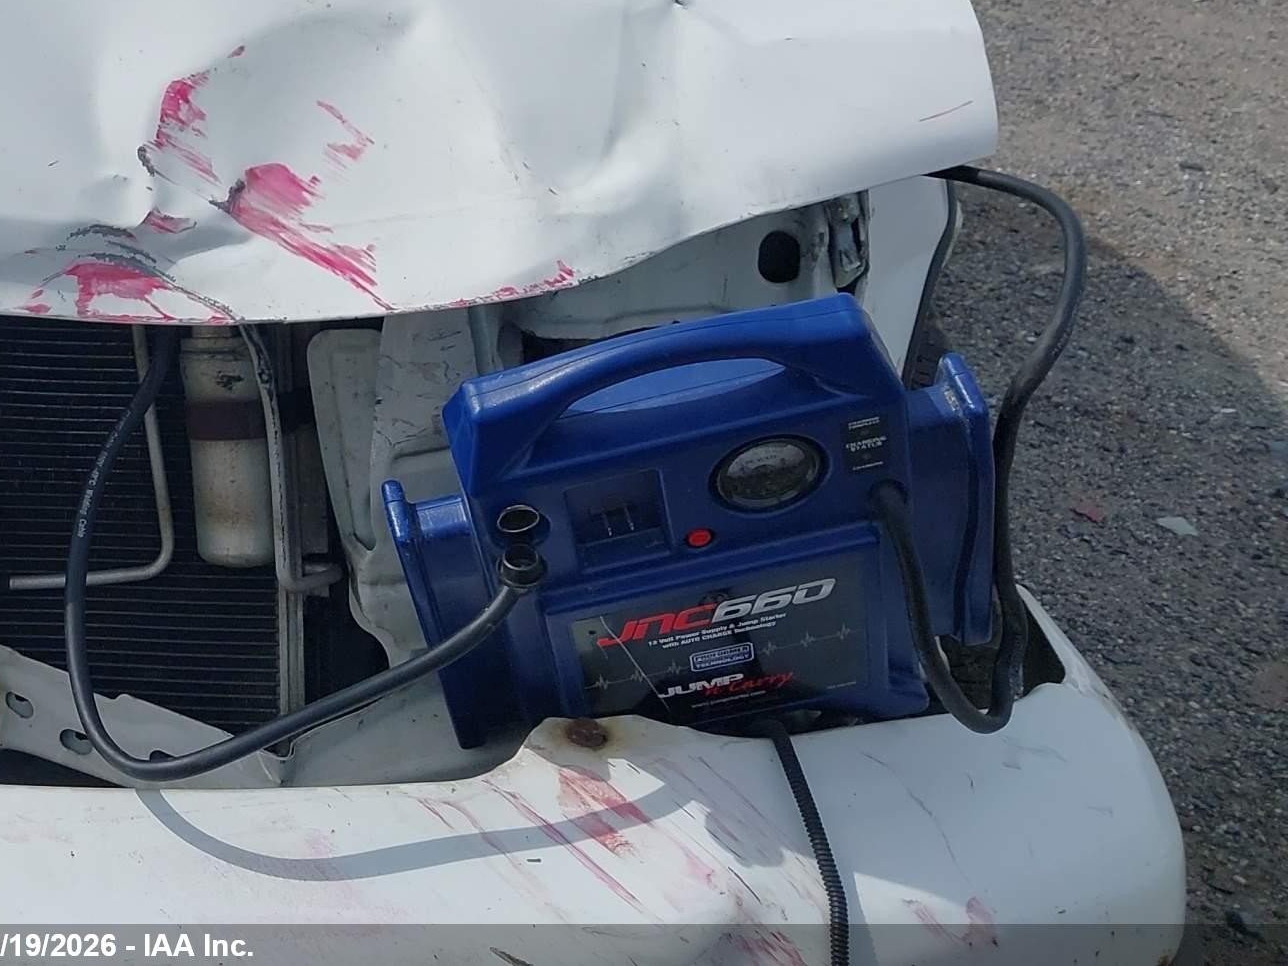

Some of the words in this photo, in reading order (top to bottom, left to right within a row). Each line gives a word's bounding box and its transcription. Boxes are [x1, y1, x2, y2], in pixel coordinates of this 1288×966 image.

[701, 625, 727, 635] Supply
[737, 618, 759, 629] Jump
[681, 636, 701, 646] AUTO
[658, 673, 744, 698] JUMP
[728, 671, 794, 693] Carry
